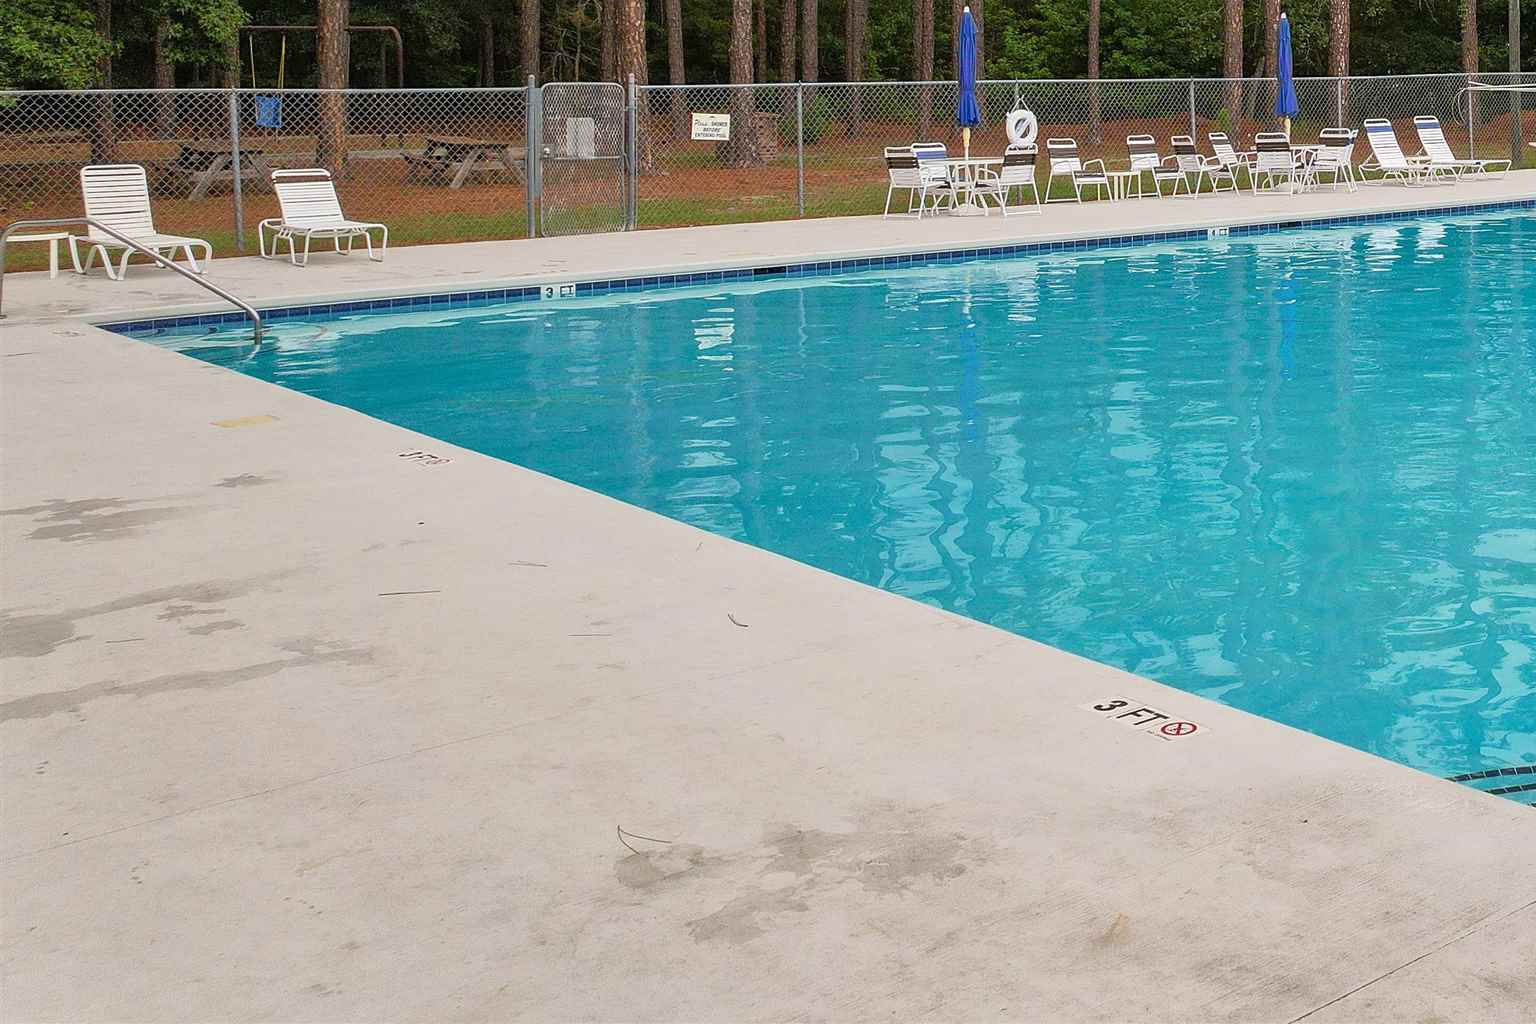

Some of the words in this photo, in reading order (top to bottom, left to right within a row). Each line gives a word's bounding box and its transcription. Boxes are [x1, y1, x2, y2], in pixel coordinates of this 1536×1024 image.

[545, 287, 554, 299] 3
[1093, 699, 1129, 712] 3
[1115, 707, 1171, 726] FT
